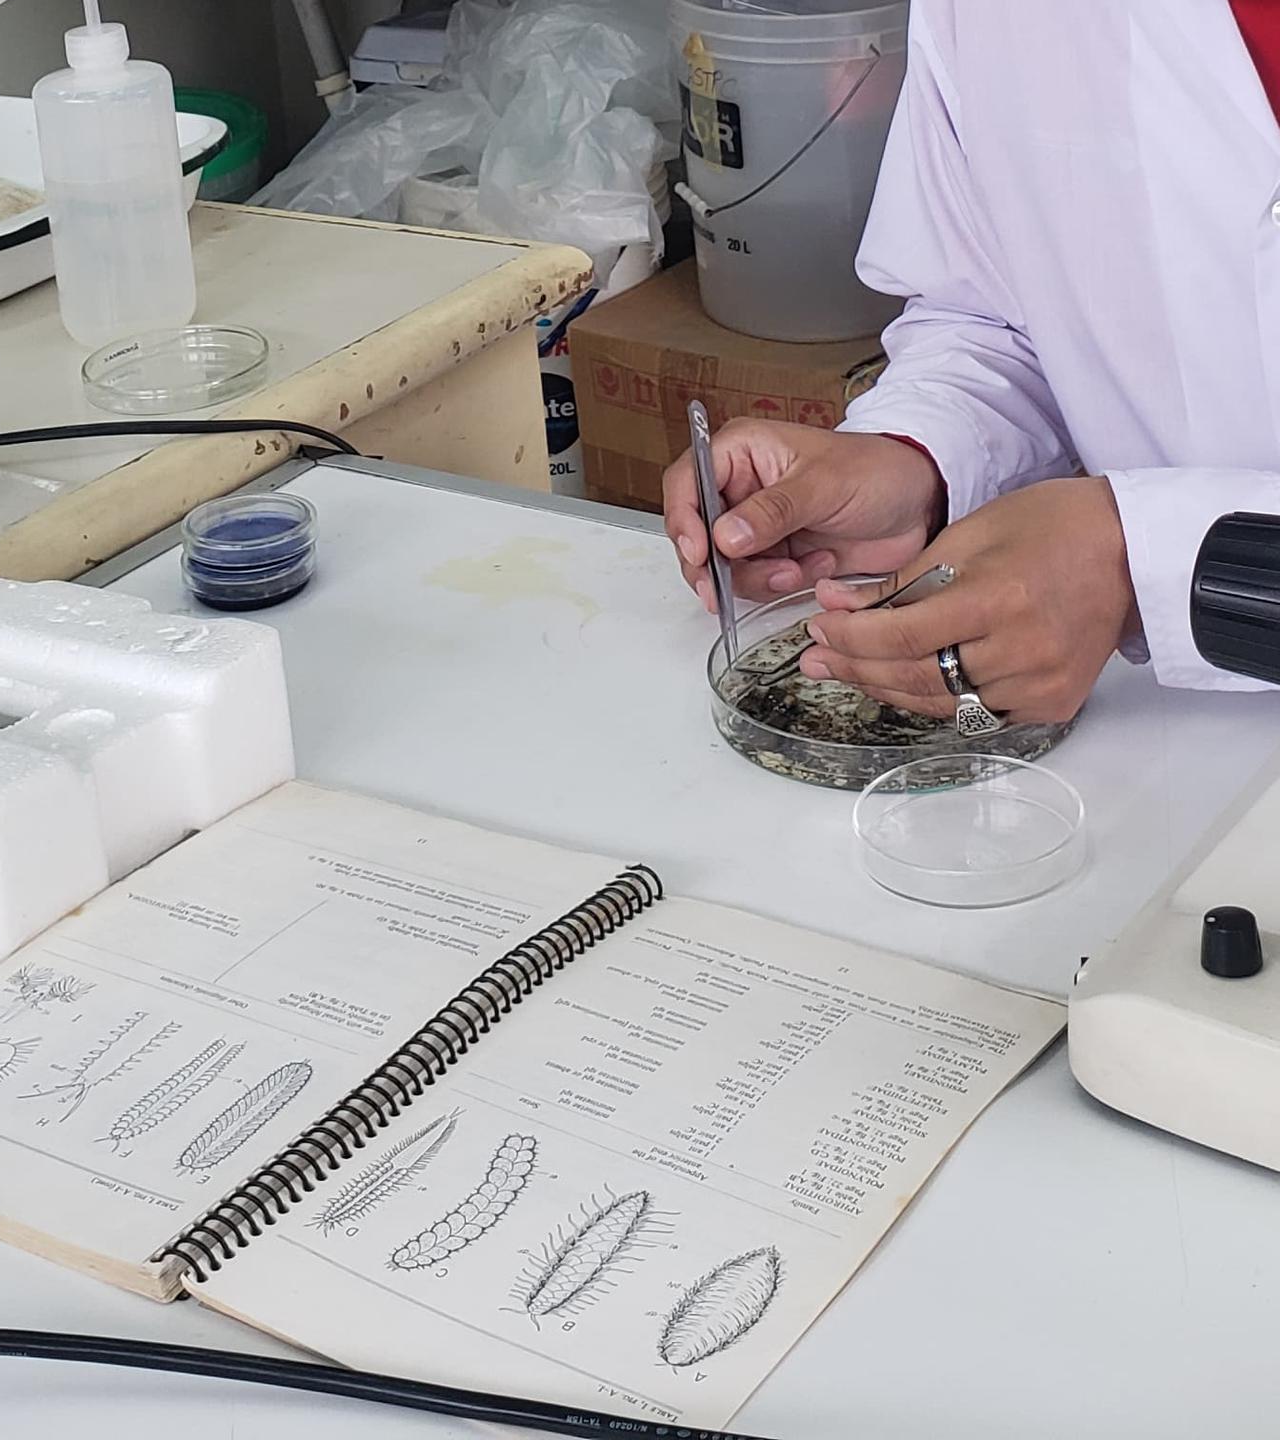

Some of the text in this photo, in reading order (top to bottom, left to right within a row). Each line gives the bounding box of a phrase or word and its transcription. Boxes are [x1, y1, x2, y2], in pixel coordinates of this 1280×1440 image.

[727, 238, 752, 254] 20 L
[549, 462, 576, 475] 20L
[196, 1174, 211, 1185] E
[435, 1268, 449, 1279] C
[562, 1320, 576, 1332] B
[694, 1372, 707, 1383] A
